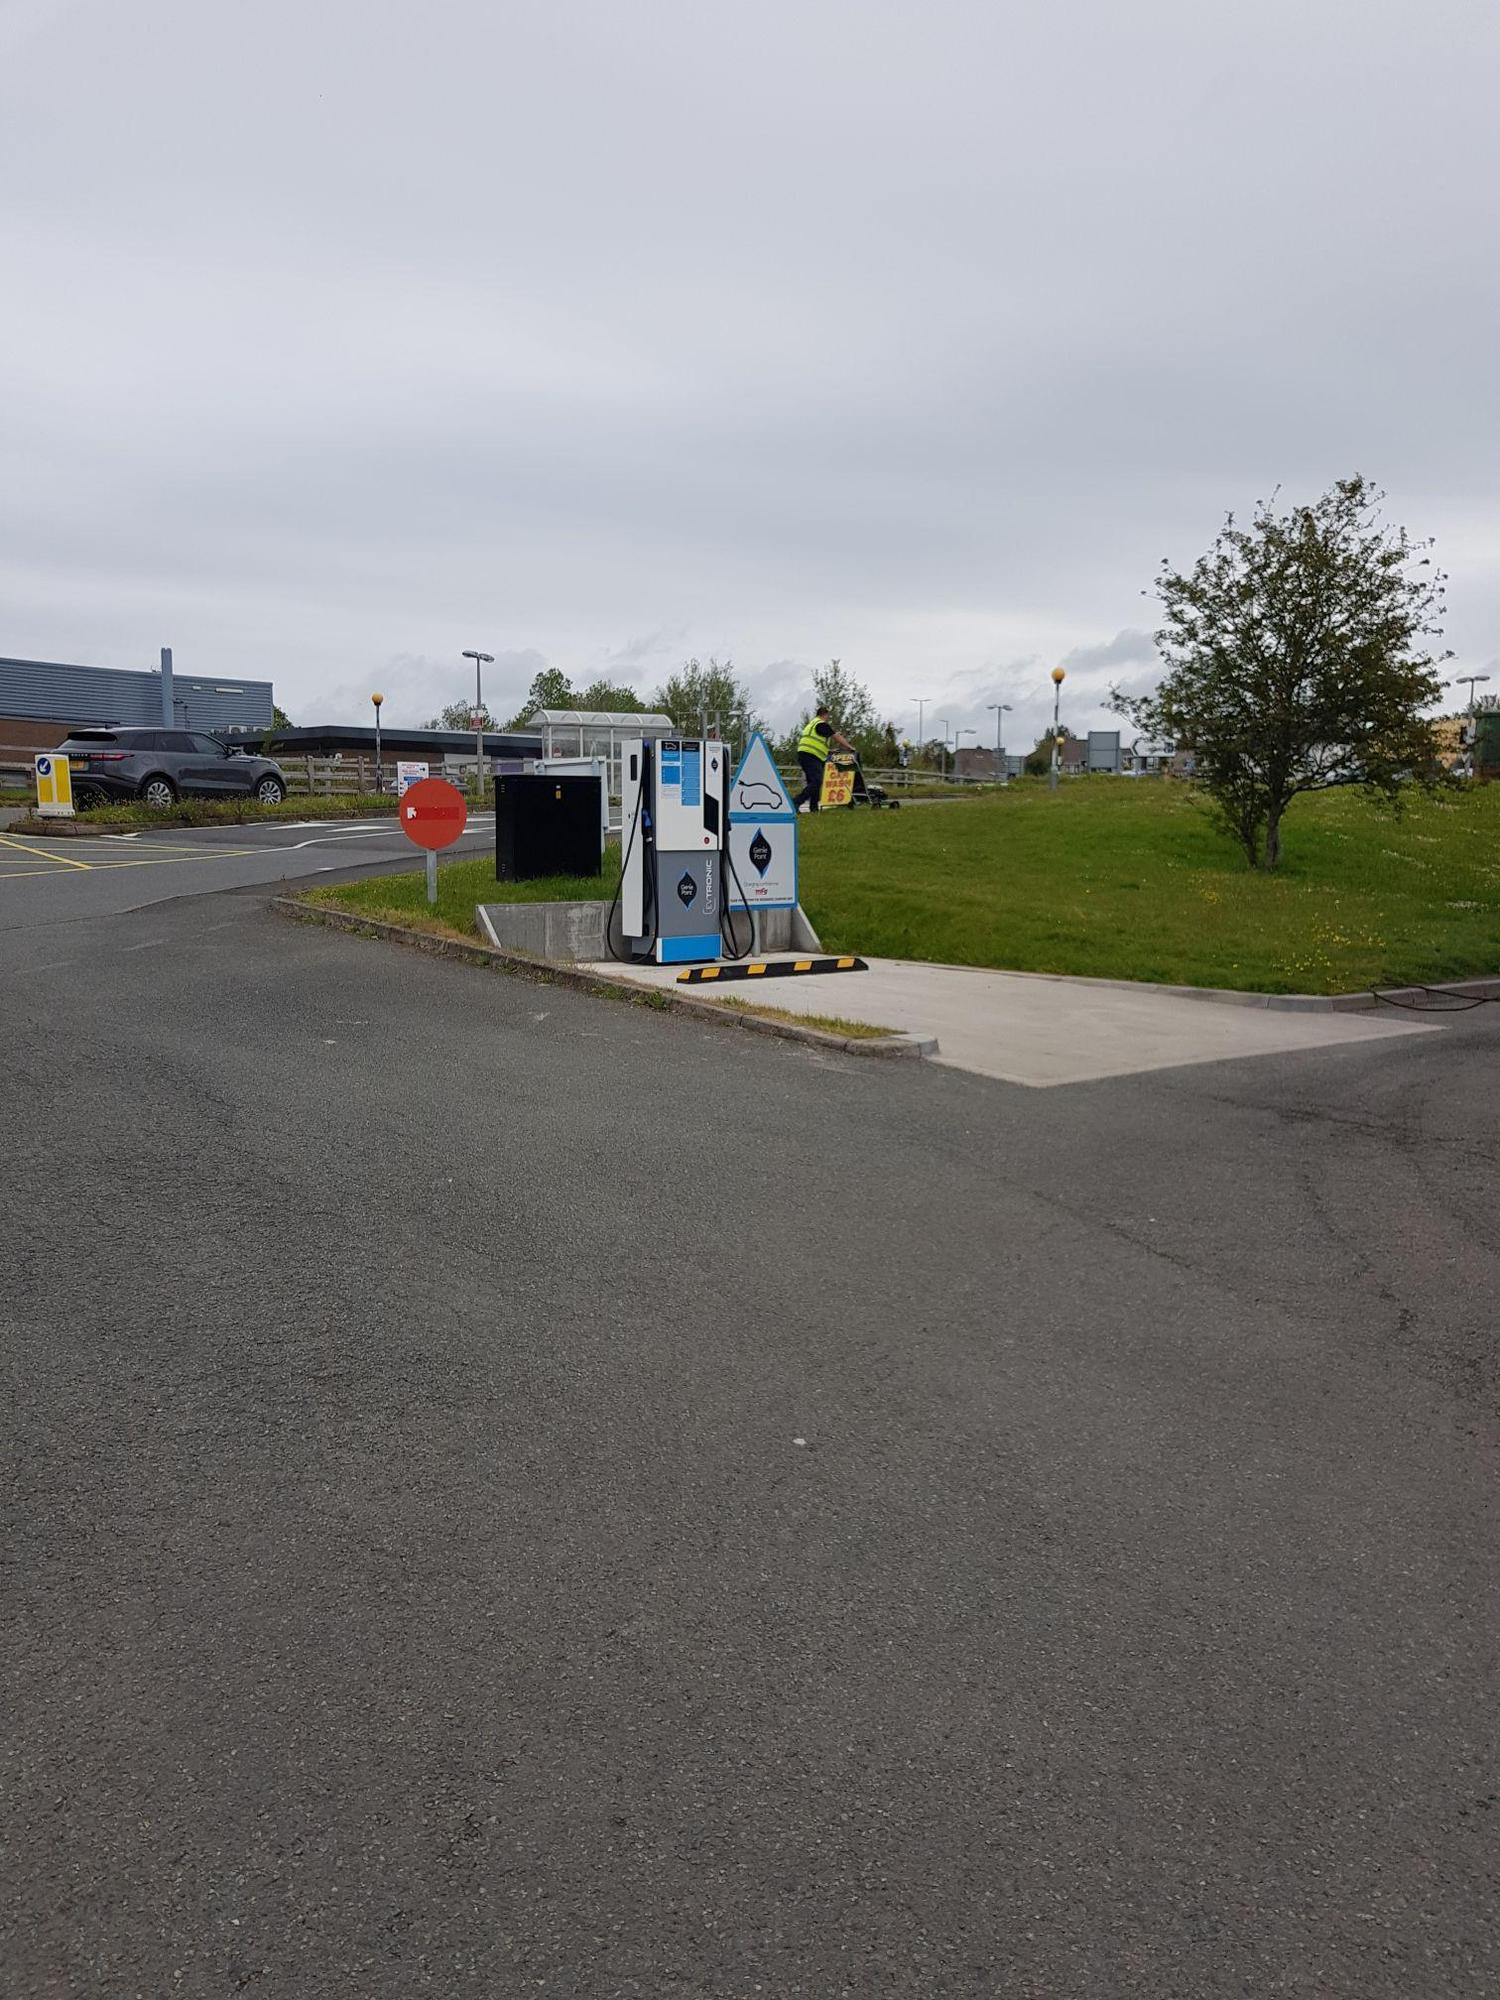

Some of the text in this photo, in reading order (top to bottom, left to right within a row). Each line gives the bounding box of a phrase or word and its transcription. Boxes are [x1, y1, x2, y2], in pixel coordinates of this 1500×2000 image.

[826, 778, 851, 788] WASH
[827, 789, 845, 803] £6
[752, 845, 768, 854] Genie
